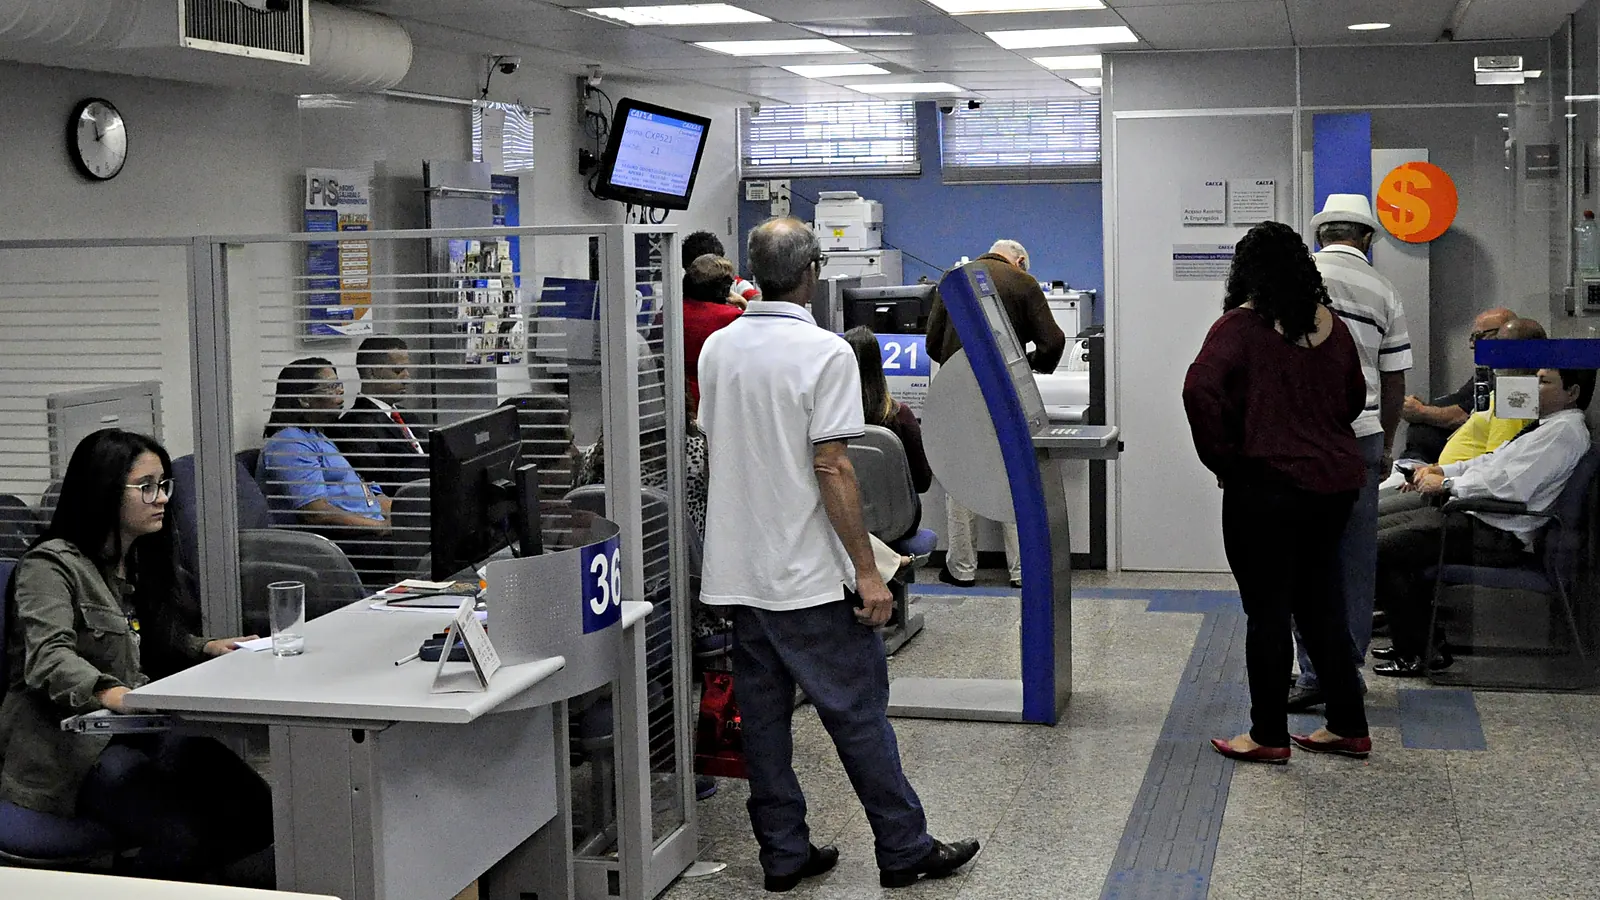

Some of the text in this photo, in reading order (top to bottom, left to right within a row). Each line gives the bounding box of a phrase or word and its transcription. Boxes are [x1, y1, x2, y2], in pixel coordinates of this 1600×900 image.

[630, 110, 653, 121] CAIXA
[682, 122, 702, 131] CAIXAS
[645, 131, 673, 144] CXP521
[650, 146, 660, 155] 21
[309, 178, 339, 207] PIS
[882, 341, 918, 370] 21
[589, 547, 621, 615] 36
